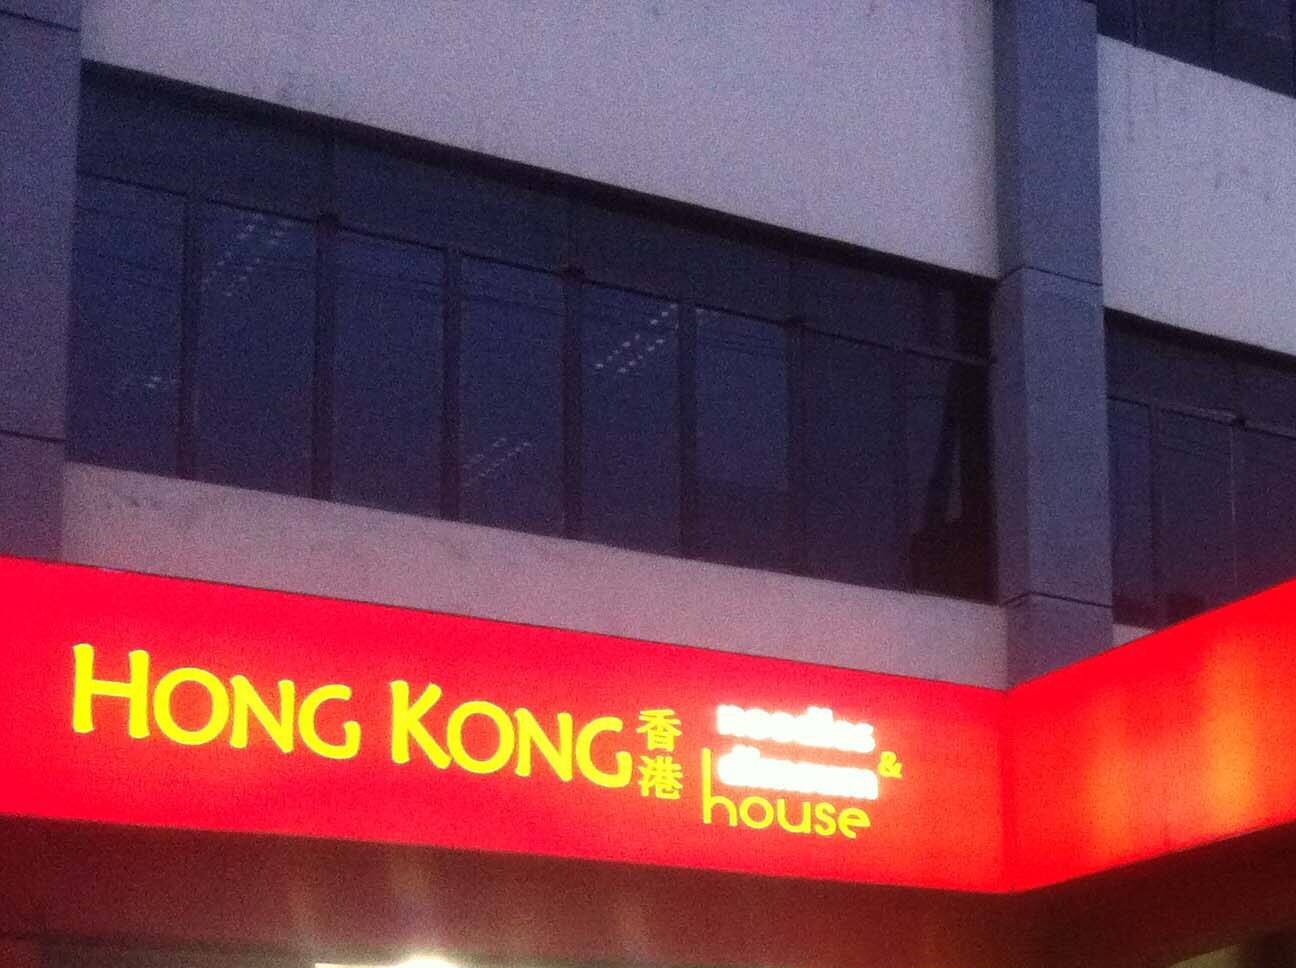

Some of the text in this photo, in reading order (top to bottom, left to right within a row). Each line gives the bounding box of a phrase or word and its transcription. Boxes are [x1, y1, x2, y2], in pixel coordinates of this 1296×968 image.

[73, 644, 360, 759] HONG
[390, 680, 632, 787] KONG
[636, 709, 683, 800] 香港
[702, 748, 870, 838] house
[878, 751, 902, 778] &
